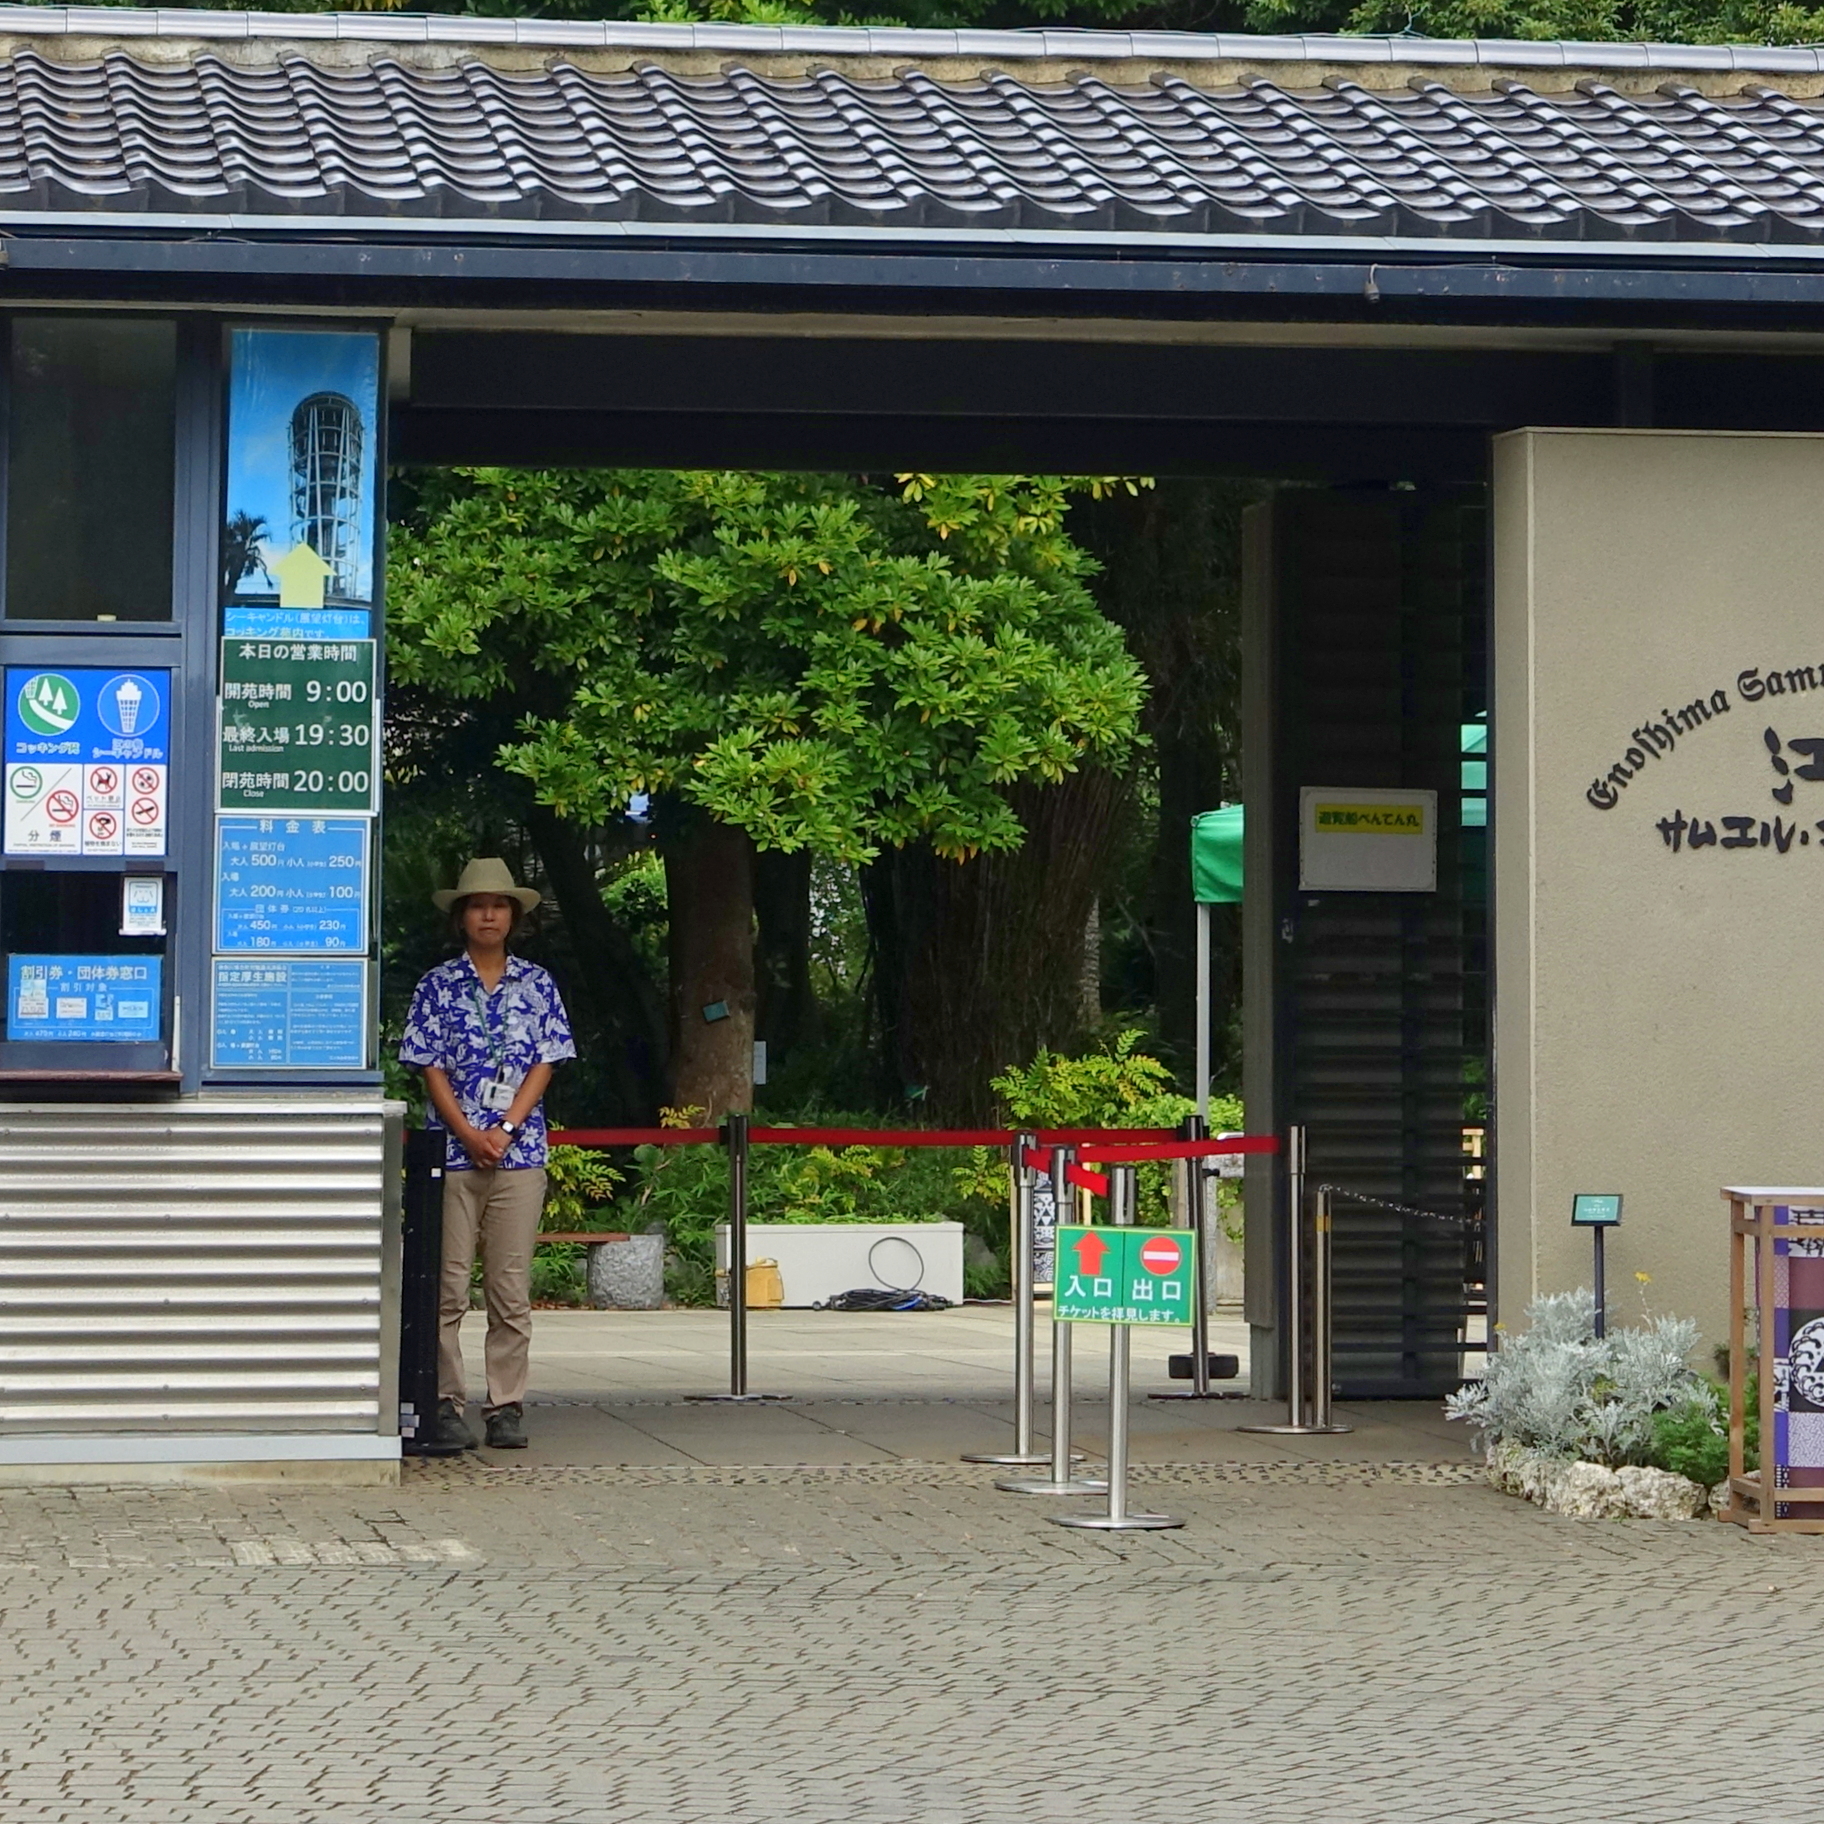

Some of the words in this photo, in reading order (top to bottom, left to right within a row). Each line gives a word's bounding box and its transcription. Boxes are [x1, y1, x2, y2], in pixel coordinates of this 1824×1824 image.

[238, 642, 357, 662] 本日の営業時間
[224, 682, 292, 700] 開苑時間
[306, 680, 367, 703] 9:00
[248, 701, 270, 709] Open
[222, 727, 290, 744] 最終入場
[294, 724, 369, 746] 19:30
[246, 745, 284, 753] admission
[221, 772, 290, 789] 閉苑時間
[293, 770, 369, 792] 20:00
[243, 790, 264, 798] Close
[28, 830, 62, 842] 分煙
[260, 819, 326, 834] 料金表
[20, 965, 148, 981] 割引券・団体券窓口
[1064, 1275, 1113, 1298] 入口
[1132, 1278, 1182, 1302] 出口
[1058, 1304, 1181, 1324] チケットを拝見します。
